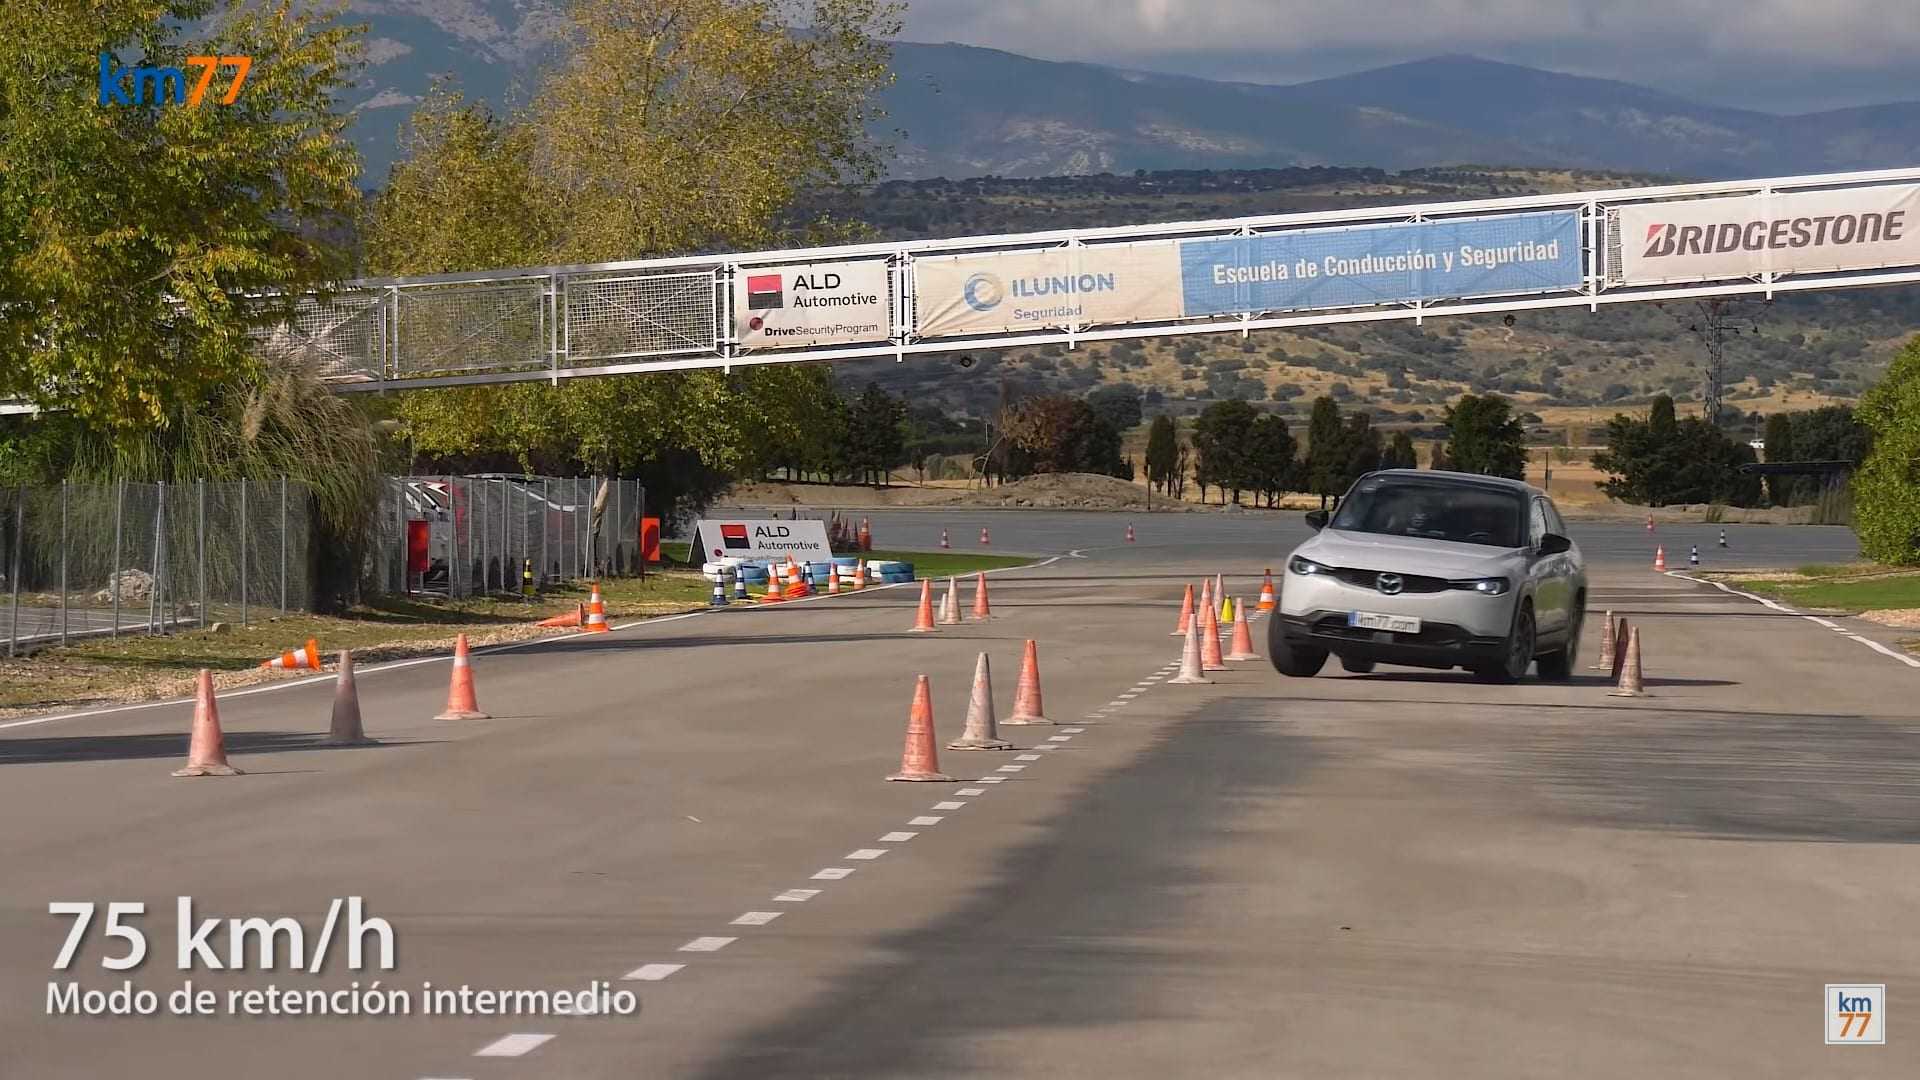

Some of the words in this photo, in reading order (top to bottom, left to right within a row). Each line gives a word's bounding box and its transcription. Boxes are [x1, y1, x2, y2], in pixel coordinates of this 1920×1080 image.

[1642, 210, 1906, 258] BRIDGESTONE
[1213, 260, 1288, 285] Escuela
[1295, 258, 1318, 278] de
[1324, 249, 1436, 276] Conducción
[1444, 252, 1454, 273] y
[1460, 239, 1559, 268] Seguridad
[792, 273, 841, 291] ALD
[1012, 272, 1115, 298] ILUNION
[793, 292, 878, 308] Automotive
[1013, 305, 1083, 321] Seguridad
[764, 322, 878, 337] DriveSecurityProgram
[755, 525, 790, 538] ALD
[757, 539, 820, 551] Automotive
